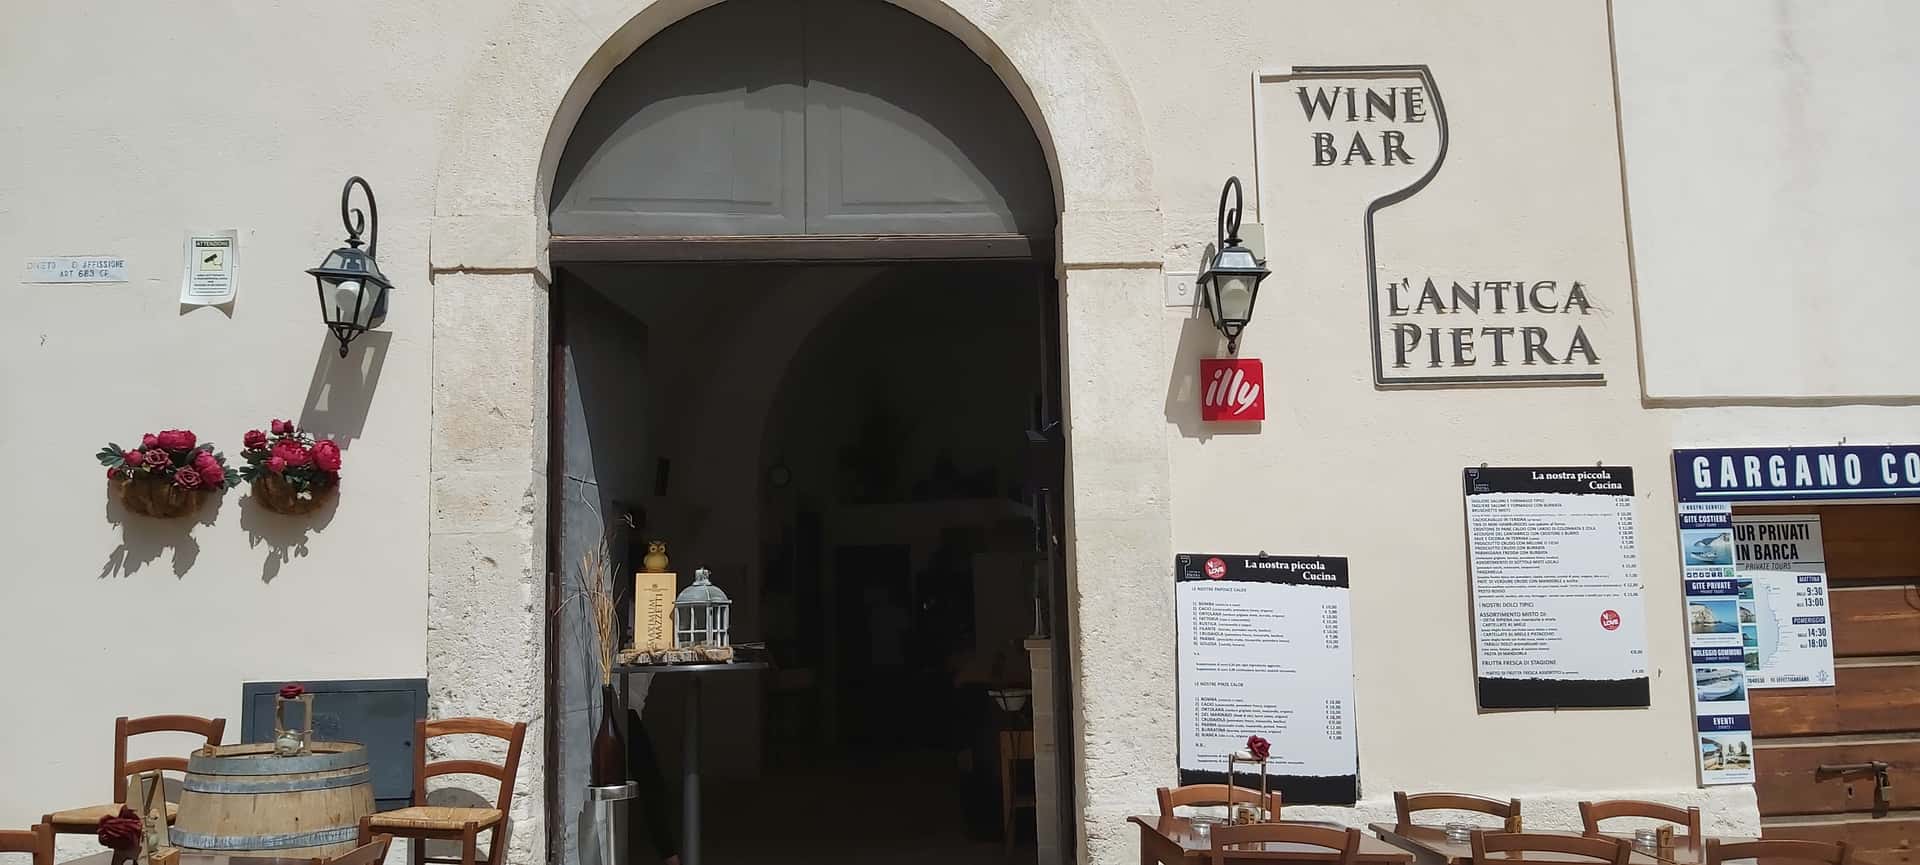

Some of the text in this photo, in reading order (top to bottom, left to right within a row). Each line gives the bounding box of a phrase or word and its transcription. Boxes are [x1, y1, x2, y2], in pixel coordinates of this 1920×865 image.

[1296, 86, 1427, 124] WINE
[1311, 130, 1416, 167] BAR
[1177, 281, 1187, 296] 9
[1390, 324, 1600, 367] PIETRA
[1204, 368, 1259, 415] illy
[1693, 452, 1920, 489] GARGANO CO
[1532, 471, 1611, 481] La nostra piccola
[1589, 480, 1622, 489] Cucina
[1684, 515, 1728, 523] GITE COSTIERE
[1758, 523, 1810, 540] PRIVATI
[1736, 544, 1799, 561] IN BARCA
[1245, 560, 1325, 572] La nostra piccola
[1745, 562, 1792, 571] PRIVATE TOURS
[1303, 571, 1336, 581] Cucina
[1692, 581, 1731, 590] GITE PRIVATE
[1806, 587, 1823, 596] 9:30
[1805, 598, 1824, 607] 13:00
[655, 593, 663, 640] MAZZETTI
[1807, 628, 1827, 637] 14:30
[1808, 639, 1828, 648] 18:00
[1693, 648, 1742, 657] NOLEGGIO GOMMONI
[1713, 717, 1734, 726] EVENTI
